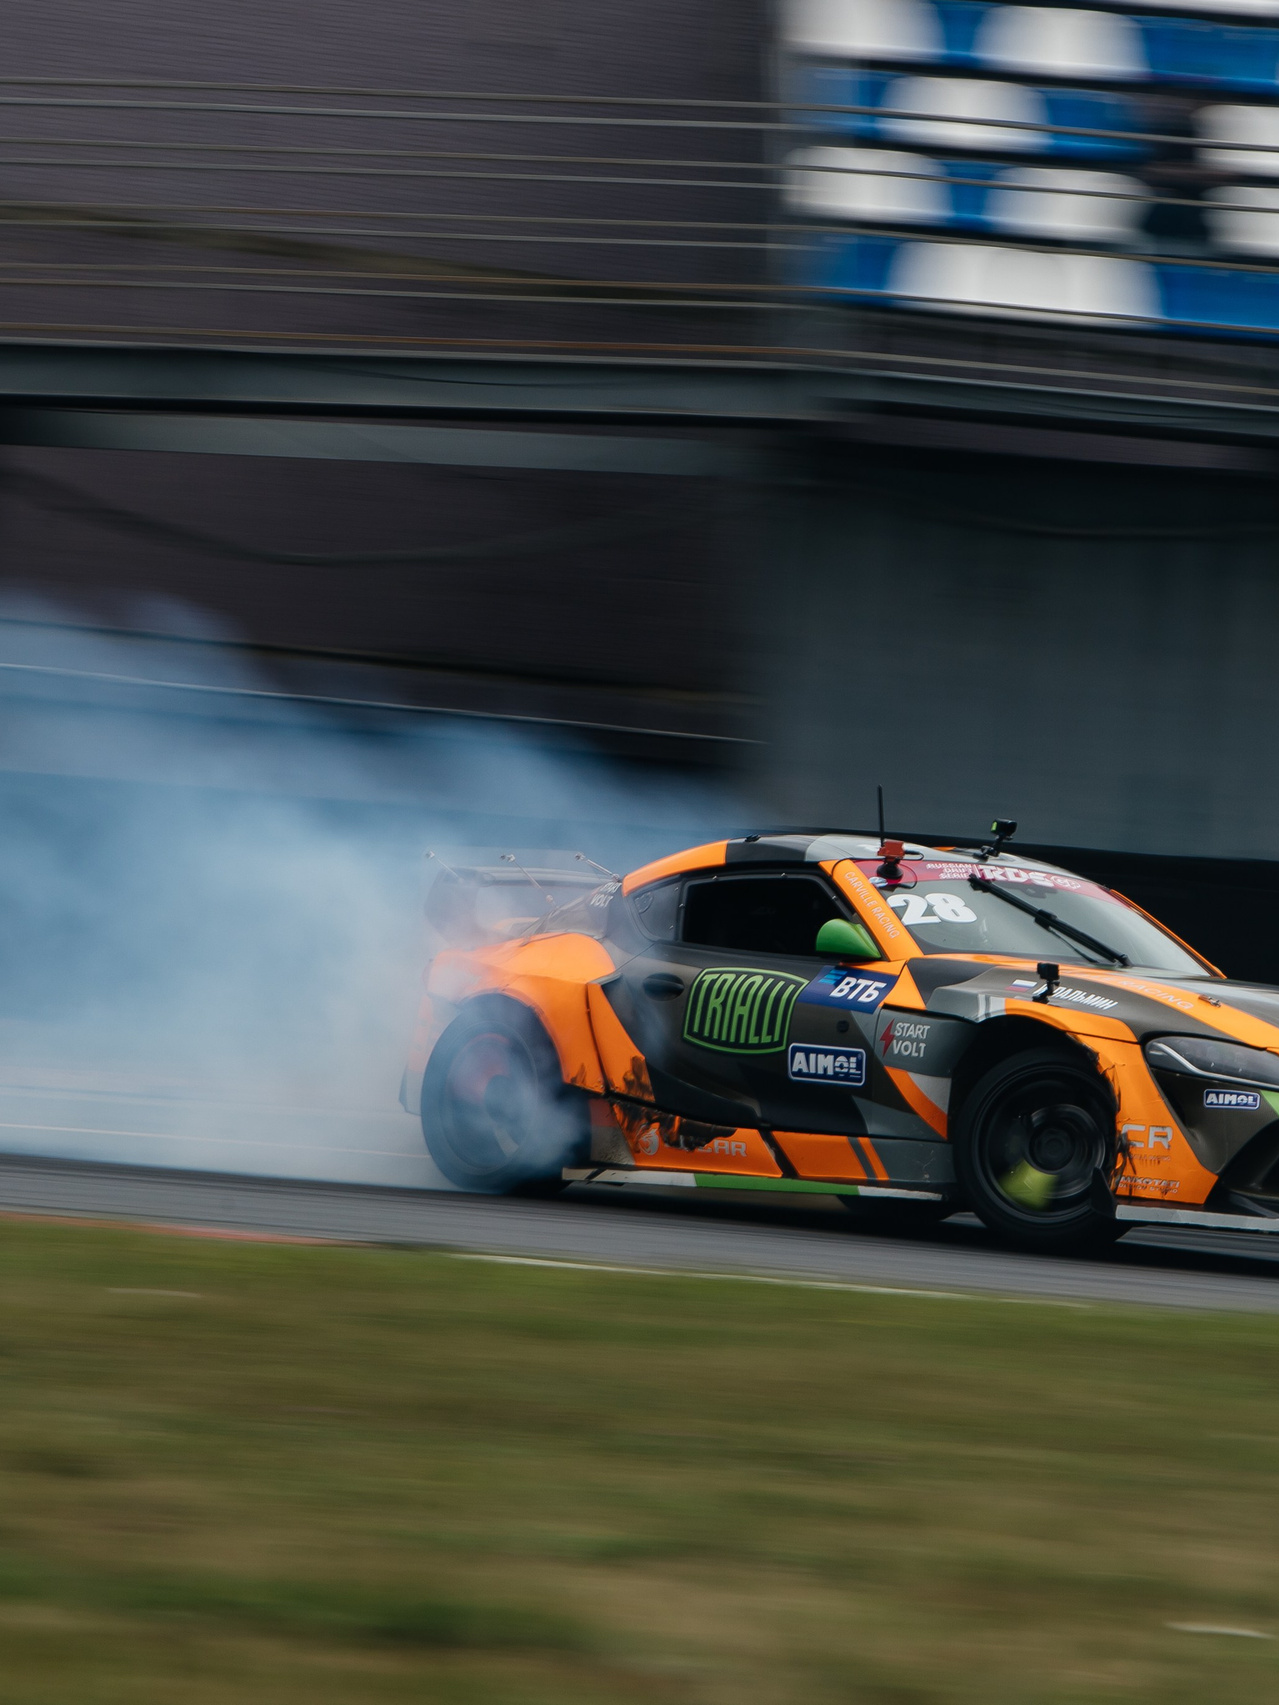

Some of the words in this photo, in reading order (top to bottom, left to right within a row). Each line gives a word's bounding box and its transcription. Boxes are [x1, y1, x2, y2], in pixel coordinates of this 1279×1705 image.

[978, 864, 1055, 888] RDS
[591, 894, 613, 907] VOLT
[844, 871, 877, 906] CARVILLE
[872, 905, 900, 939] RACING
[886, 892, 978, 926] 28
[830, 976, 887, 1003] ВТБ
[1117, 980, 1195, 1010] RACING
[694, 974, 795, 1044] TRIALLI
[894, 1022, 931, 1040] START
[892, 1040, 927, 1058] VOLT
[792, 1052, 861, 1076] AIMOL
[1206, 1092, 1257, 1106] AIMOL
